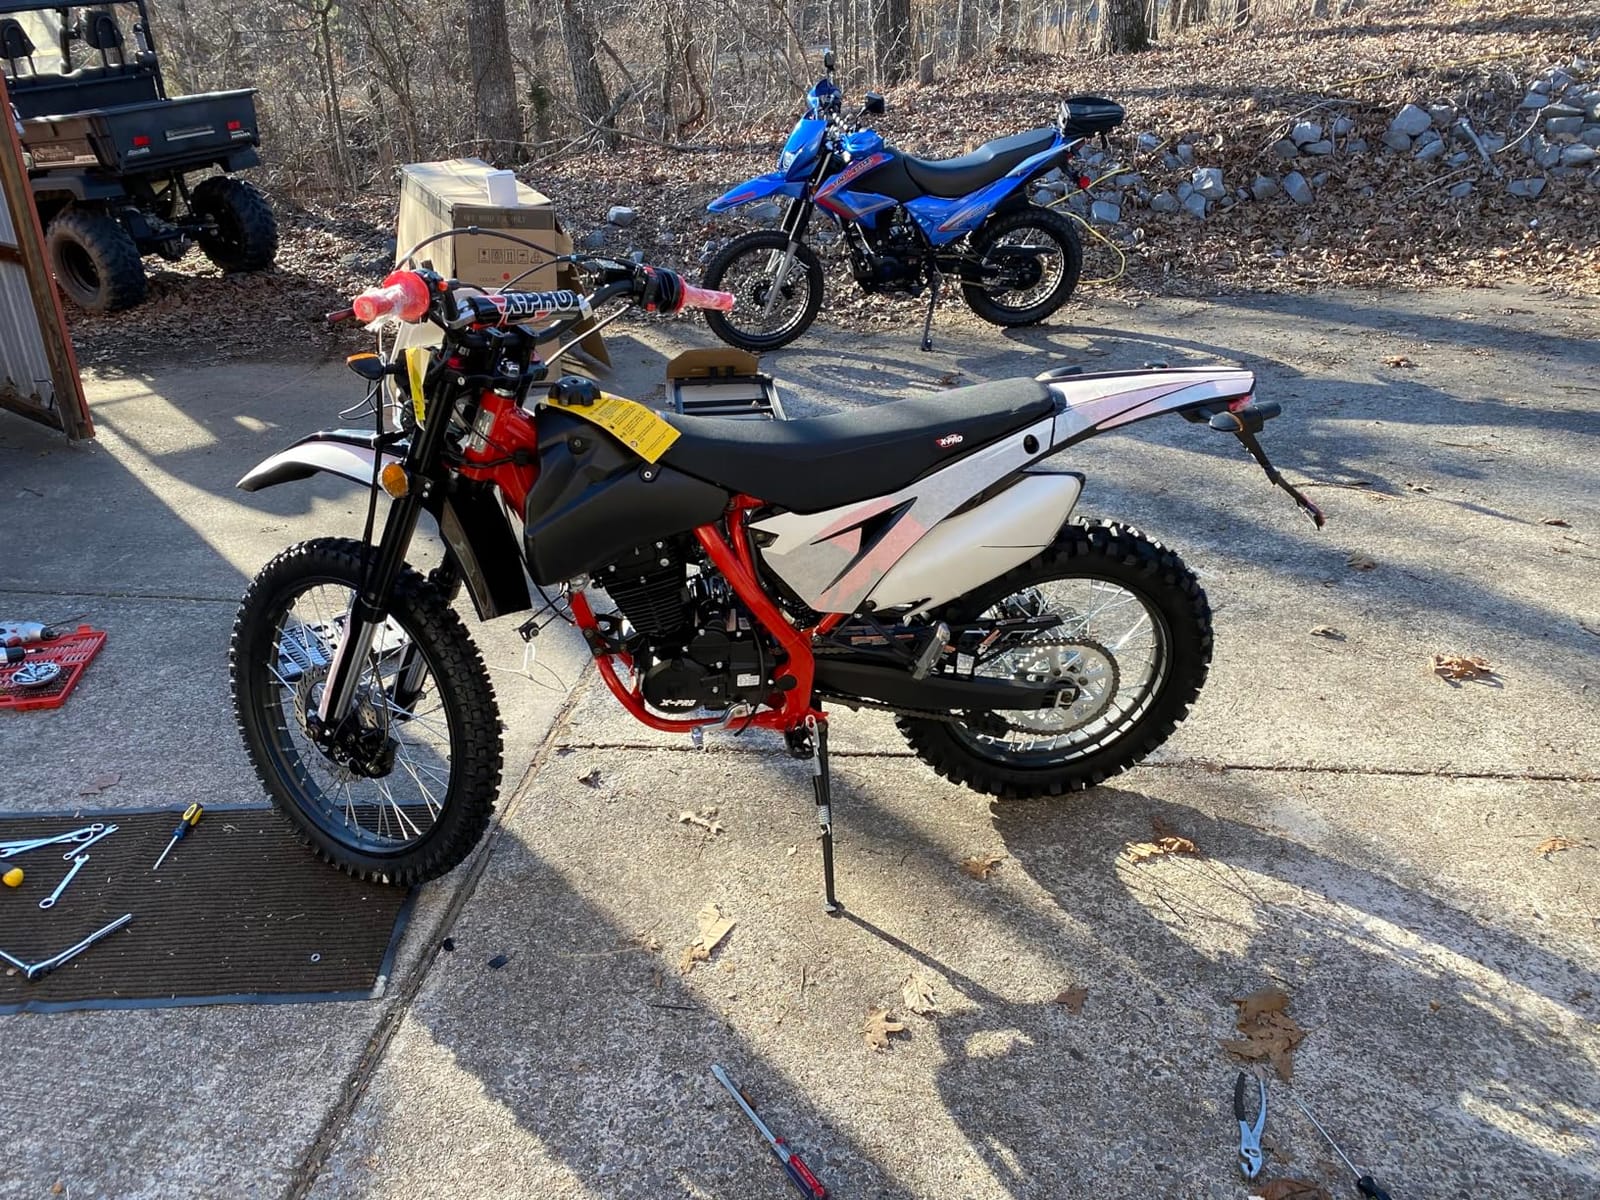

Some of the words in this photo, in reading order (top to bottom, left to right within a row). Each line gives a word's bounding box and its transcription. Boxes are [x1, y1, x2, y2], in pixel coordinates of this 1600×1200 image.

[502, 289, 573, 314] X-PRO
[940, 435, 963, 446] X-PRO
[659, 699, 696, 707] X-PRO
